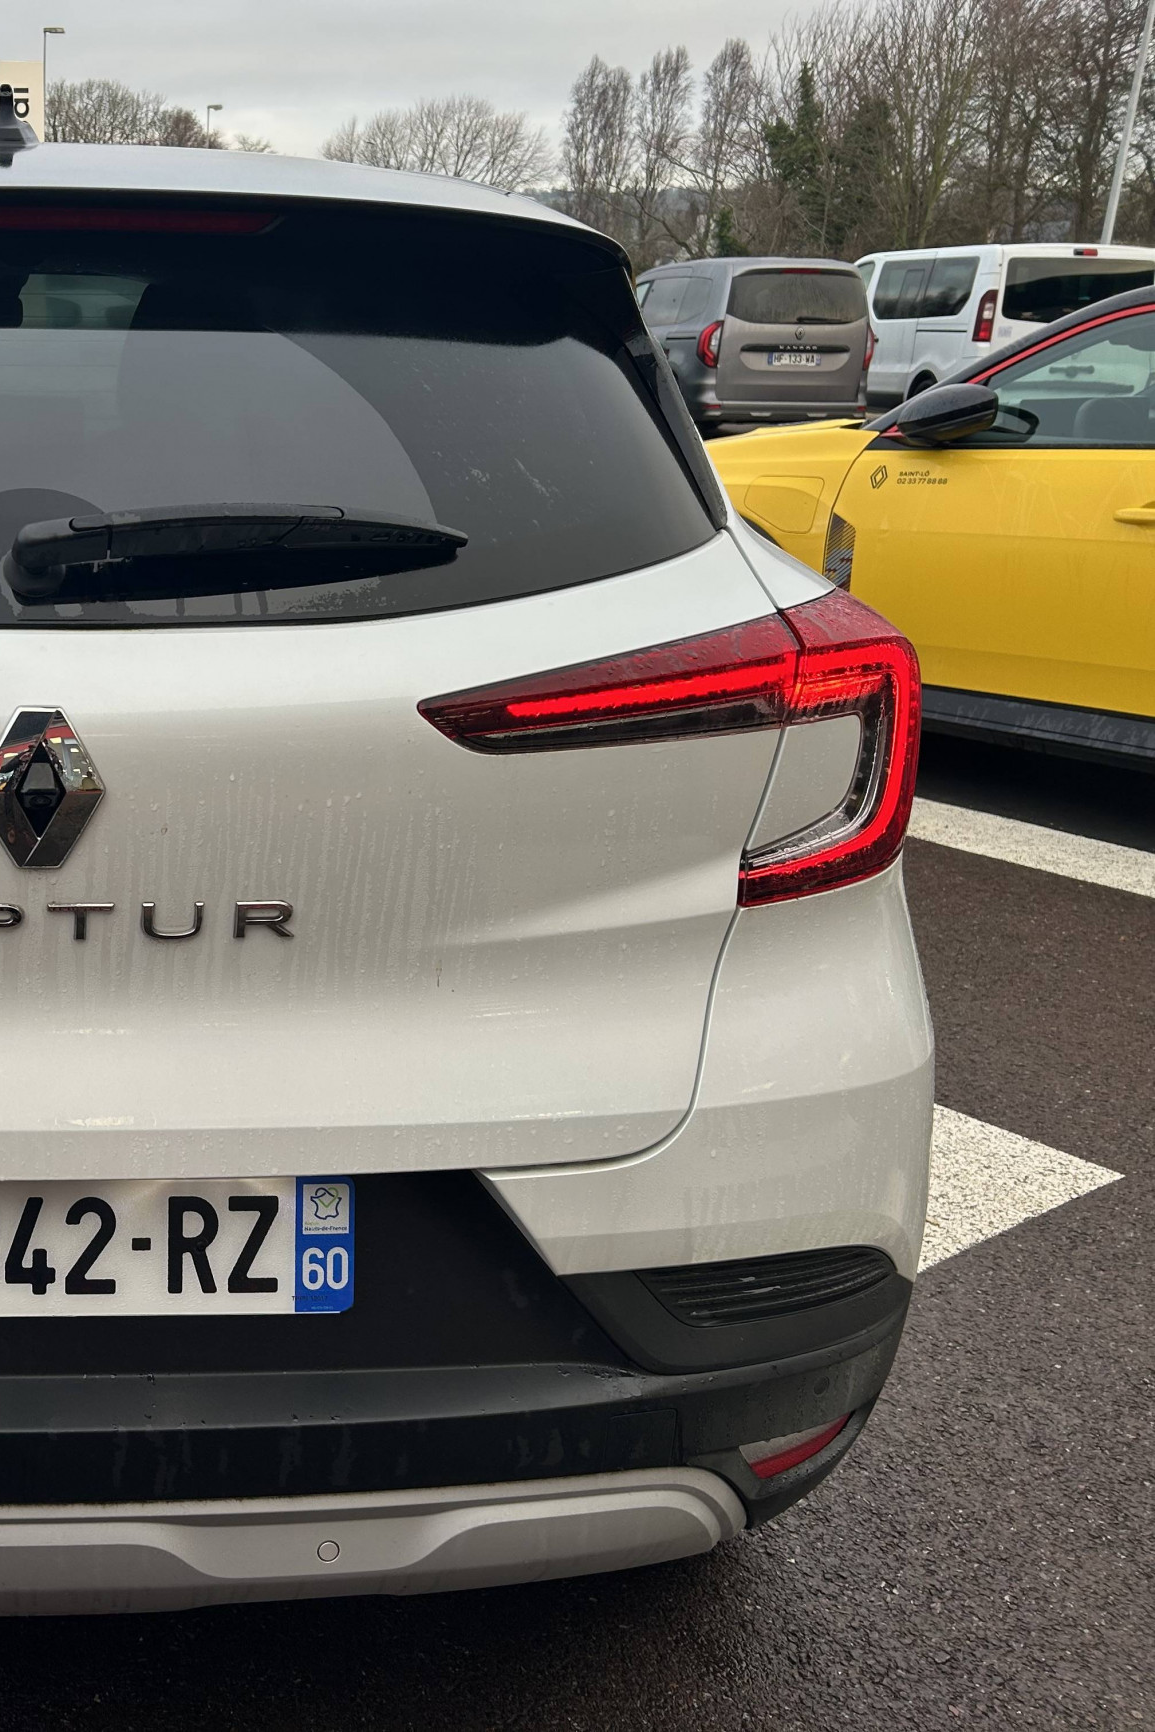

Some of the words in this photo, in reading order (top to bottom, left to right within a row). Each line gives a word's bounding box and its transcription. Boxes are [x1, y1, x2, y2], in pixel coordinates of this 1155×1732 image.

[896, 477, 907, 485] 02
[907, 477, 917, 485] 33
[917, 477, 927, 485] 77
[302, 1246, 349, 1290] 60
